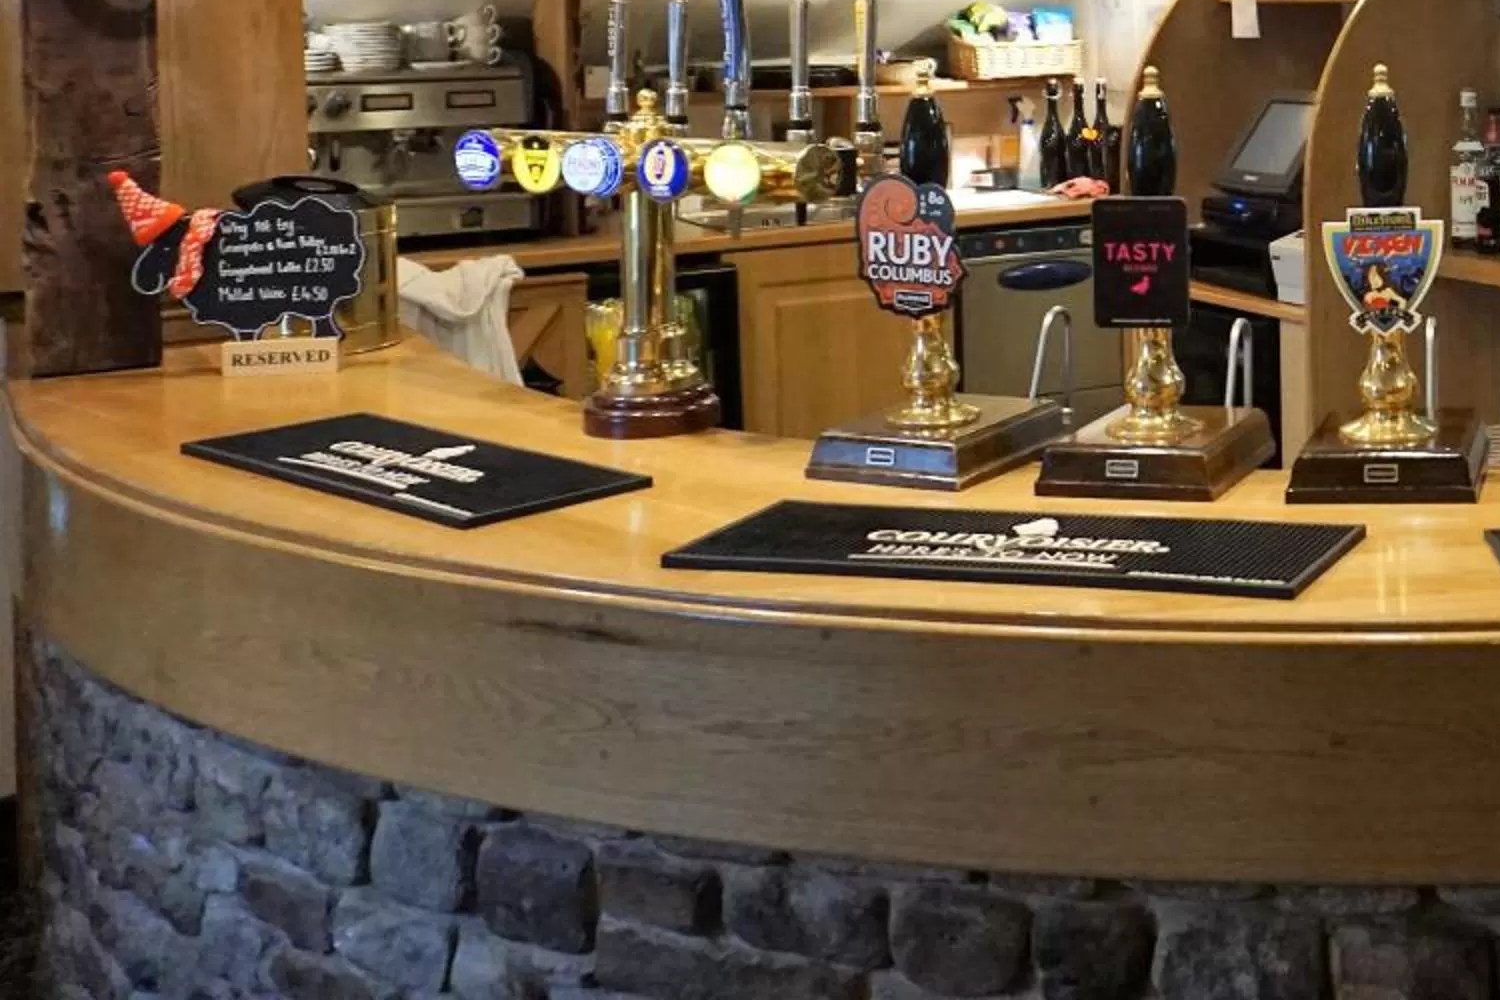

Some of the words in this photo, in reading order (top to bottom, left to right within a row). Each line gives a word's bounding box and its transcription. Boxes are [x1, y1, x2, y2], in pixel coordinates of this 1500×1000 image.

[868, 231, 953, 268] RUBY
[1104, 243, 1176, 262] TASTY
[869, 264, 953, 286] COLUMBUS
[231, 349, 332, 367] RESERVED
[1033, 550, 1120, 564] NOW
